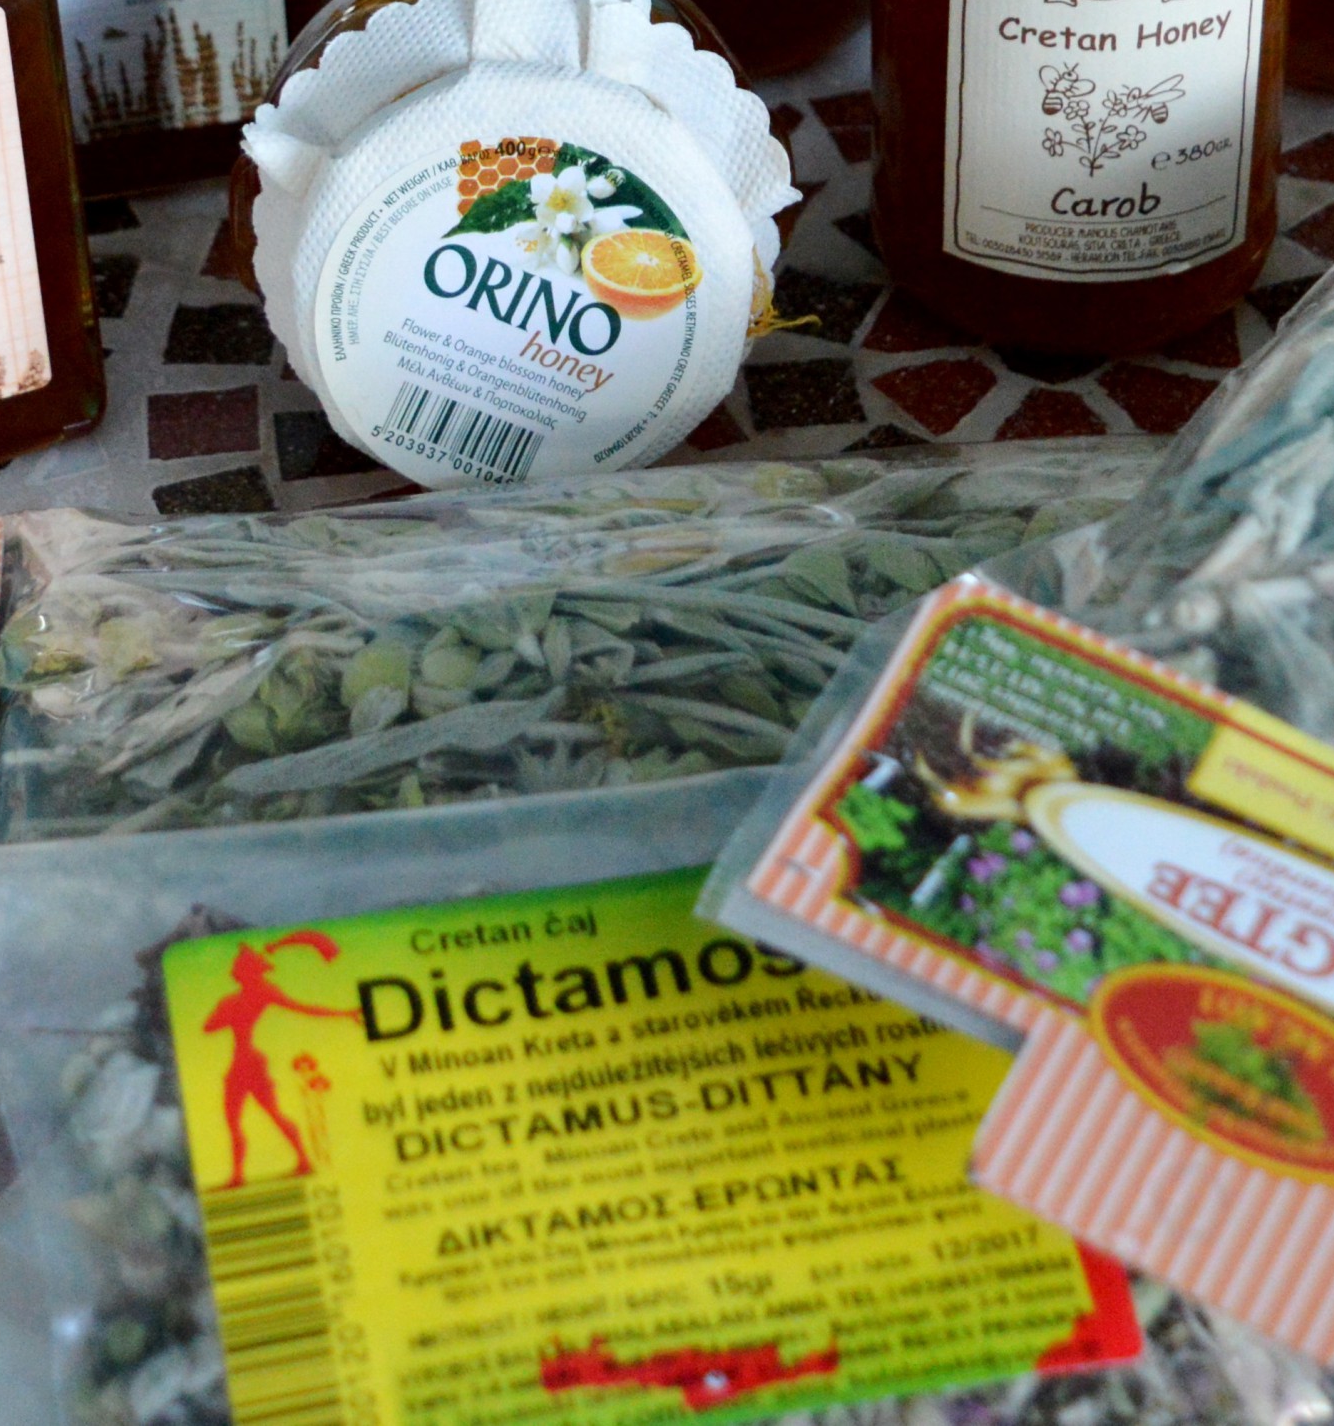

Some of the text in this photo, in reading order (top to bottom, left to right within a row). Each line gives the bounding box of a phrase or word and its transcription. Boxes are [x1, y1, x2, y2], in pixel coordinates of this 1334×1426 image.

[998, 9, 1233, 52] Cretan Honey
[339, 248, 357, 275] GREEK
[350, 214, 381, 249] PRODUCT
[382, 192, 400, 208] NET
[398, 169, 431, 195] WEIGHT
[1050, 181, 1162, 218] Carob
[669, 239, 693, 282] CRETAMEL
[423, 242, 623, 357] ORINO
[400, 317, 586, 402] Flower & Orange blossom honey
[518, 329, 616, 394] honey
[679, 311, 698, 358] RETHYMNO
[382, 330, 588, 424] Blütenhonig & Orangenblütenhonig
[397, 355, 560, 431] Μέλι Ανθέων & Πορτοκαλιάς
[654, 381, 678, 412] GREECE
[670, 358, 689, 384] CRETE
[371, 424, 381, 438] 5
[383, 432, 448, 464] 203937
[409, 907, 599, 956] Cretan čaj
[356, 936, 809, 1043] Dictamos
[379, 1054, 399, 1082] V
[408, 1037, 515, 1076] Minoan
[522, 1027, 598, 1063] Kreta
[606, 1026, 623, 1044] a
[361, 1096, 409, 1127] byl
[415, 1084, 498, 1123] jeden
[502, 1084, 518, 1104] z
[393, 1053, 924, 1164] DICTAMUS-DITTANY
[435, 1154, 907, 1258] ΔΙΚΤΑΜΟΣ-ΕΡΩΝΤΑΣ
